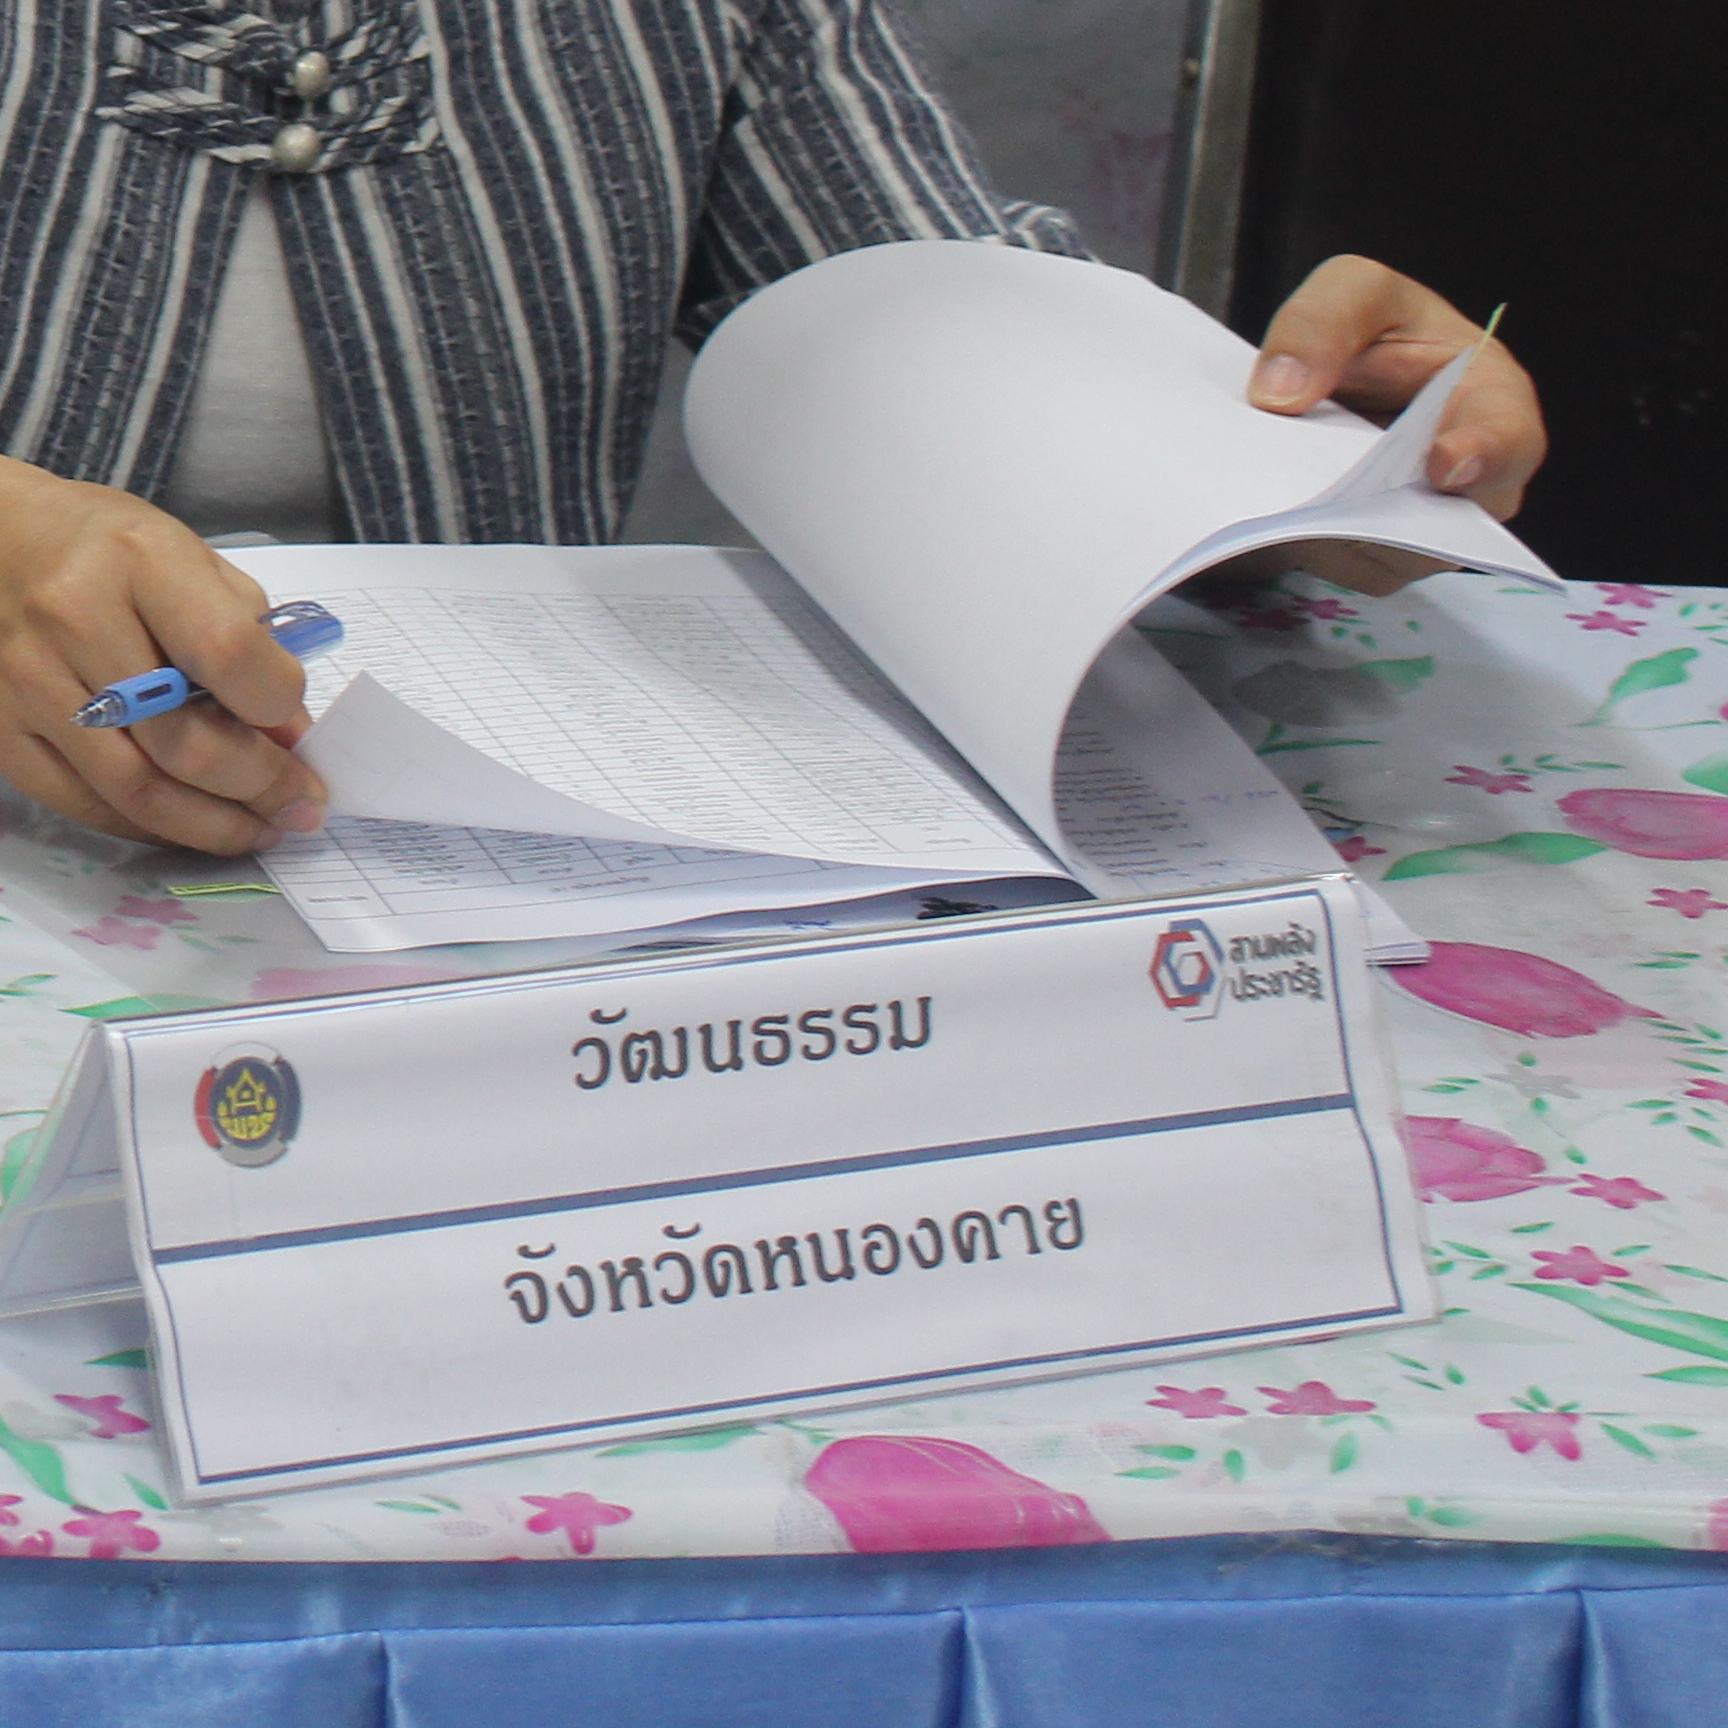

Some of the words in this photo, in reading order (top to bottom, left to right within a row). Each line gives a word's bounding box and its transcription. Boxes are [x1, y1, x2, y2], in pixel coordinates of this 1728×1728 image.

[570, 990, 936, 1093] วัฒนธรรม
[504, 1194, 1087, 1327] จังหวัดหนองคาย
